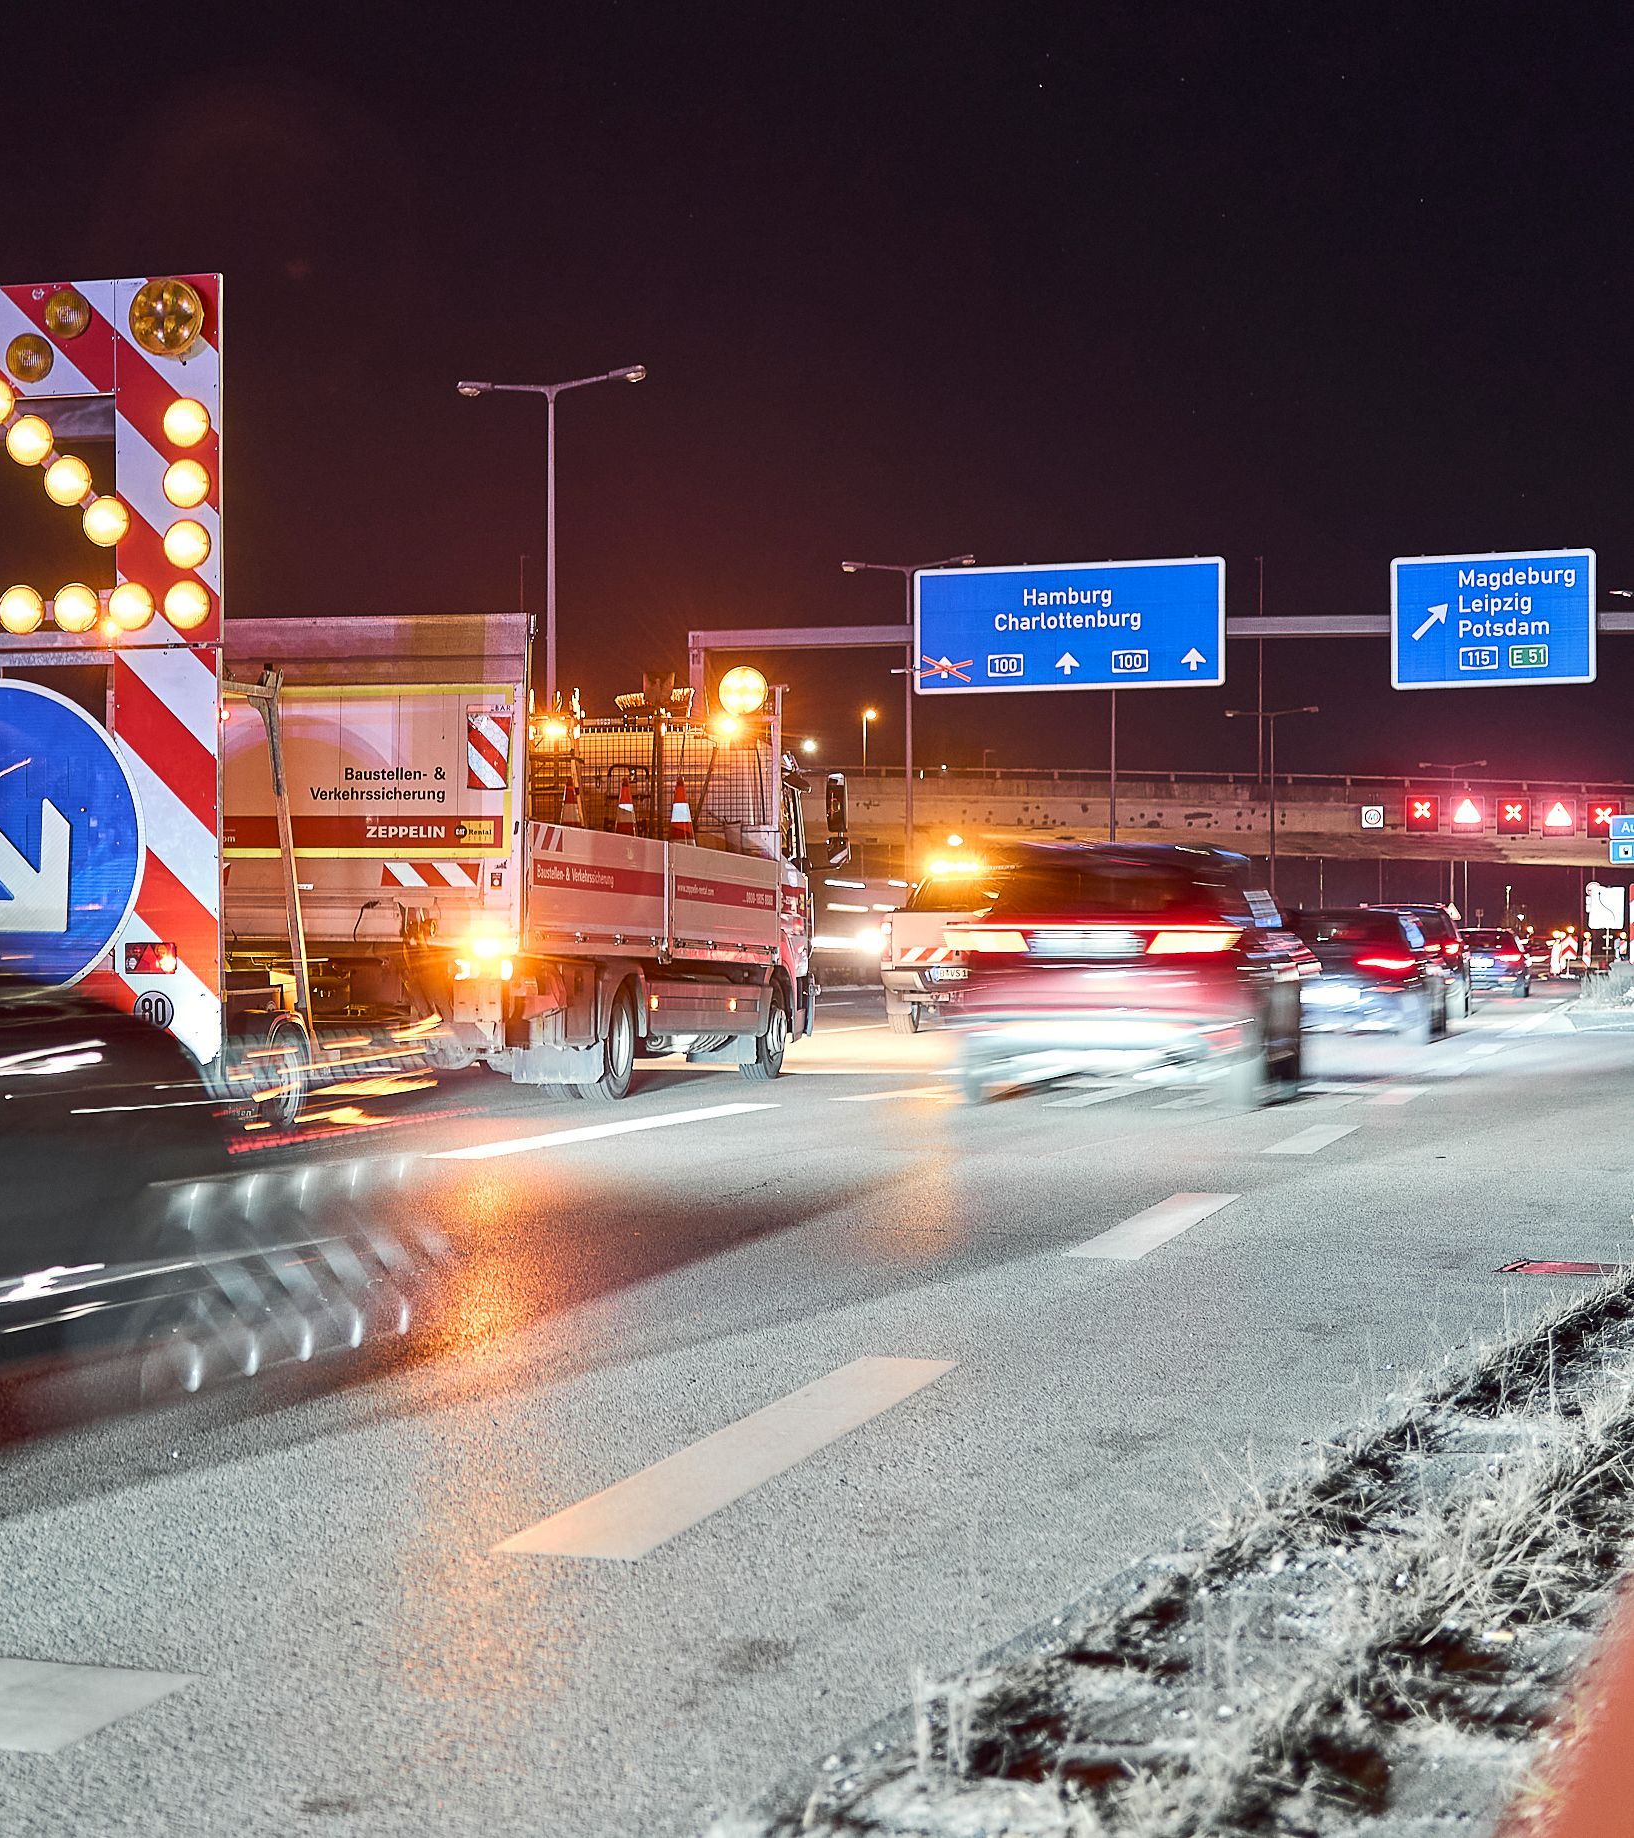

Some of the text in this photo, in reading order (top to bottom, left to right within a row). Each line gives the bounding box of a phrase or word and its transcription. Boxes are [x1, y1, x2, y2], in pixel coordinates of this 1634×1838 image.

[1458, 566, 1576, 591] Magdeburg
[1023, 586, 1112, 608] Hamburg
[1458, 592, 1532, 616] Leipzig
[994, 610, 1142, 631] Charlottenburg
[1458, 617, 1550, 638] Potsdam
[1118, 653, 1143, 669] 100
[1467, 650, 1490, 666] 115
[1513, 648, 1545, 664] E 51
[993, 658, 1018, 673] 100
[344, 766, 446, 781] Baustellen- &
[310, 787, 446, 803] Verkehrssicherung
[366, 825, 446, 839] ZEPPELIN
[468, 828, 492, 836] Rental
[537, 864, 614, 888] Baustellen- & Verkehrssicherung
[141, 997, 166, 1025] 80
